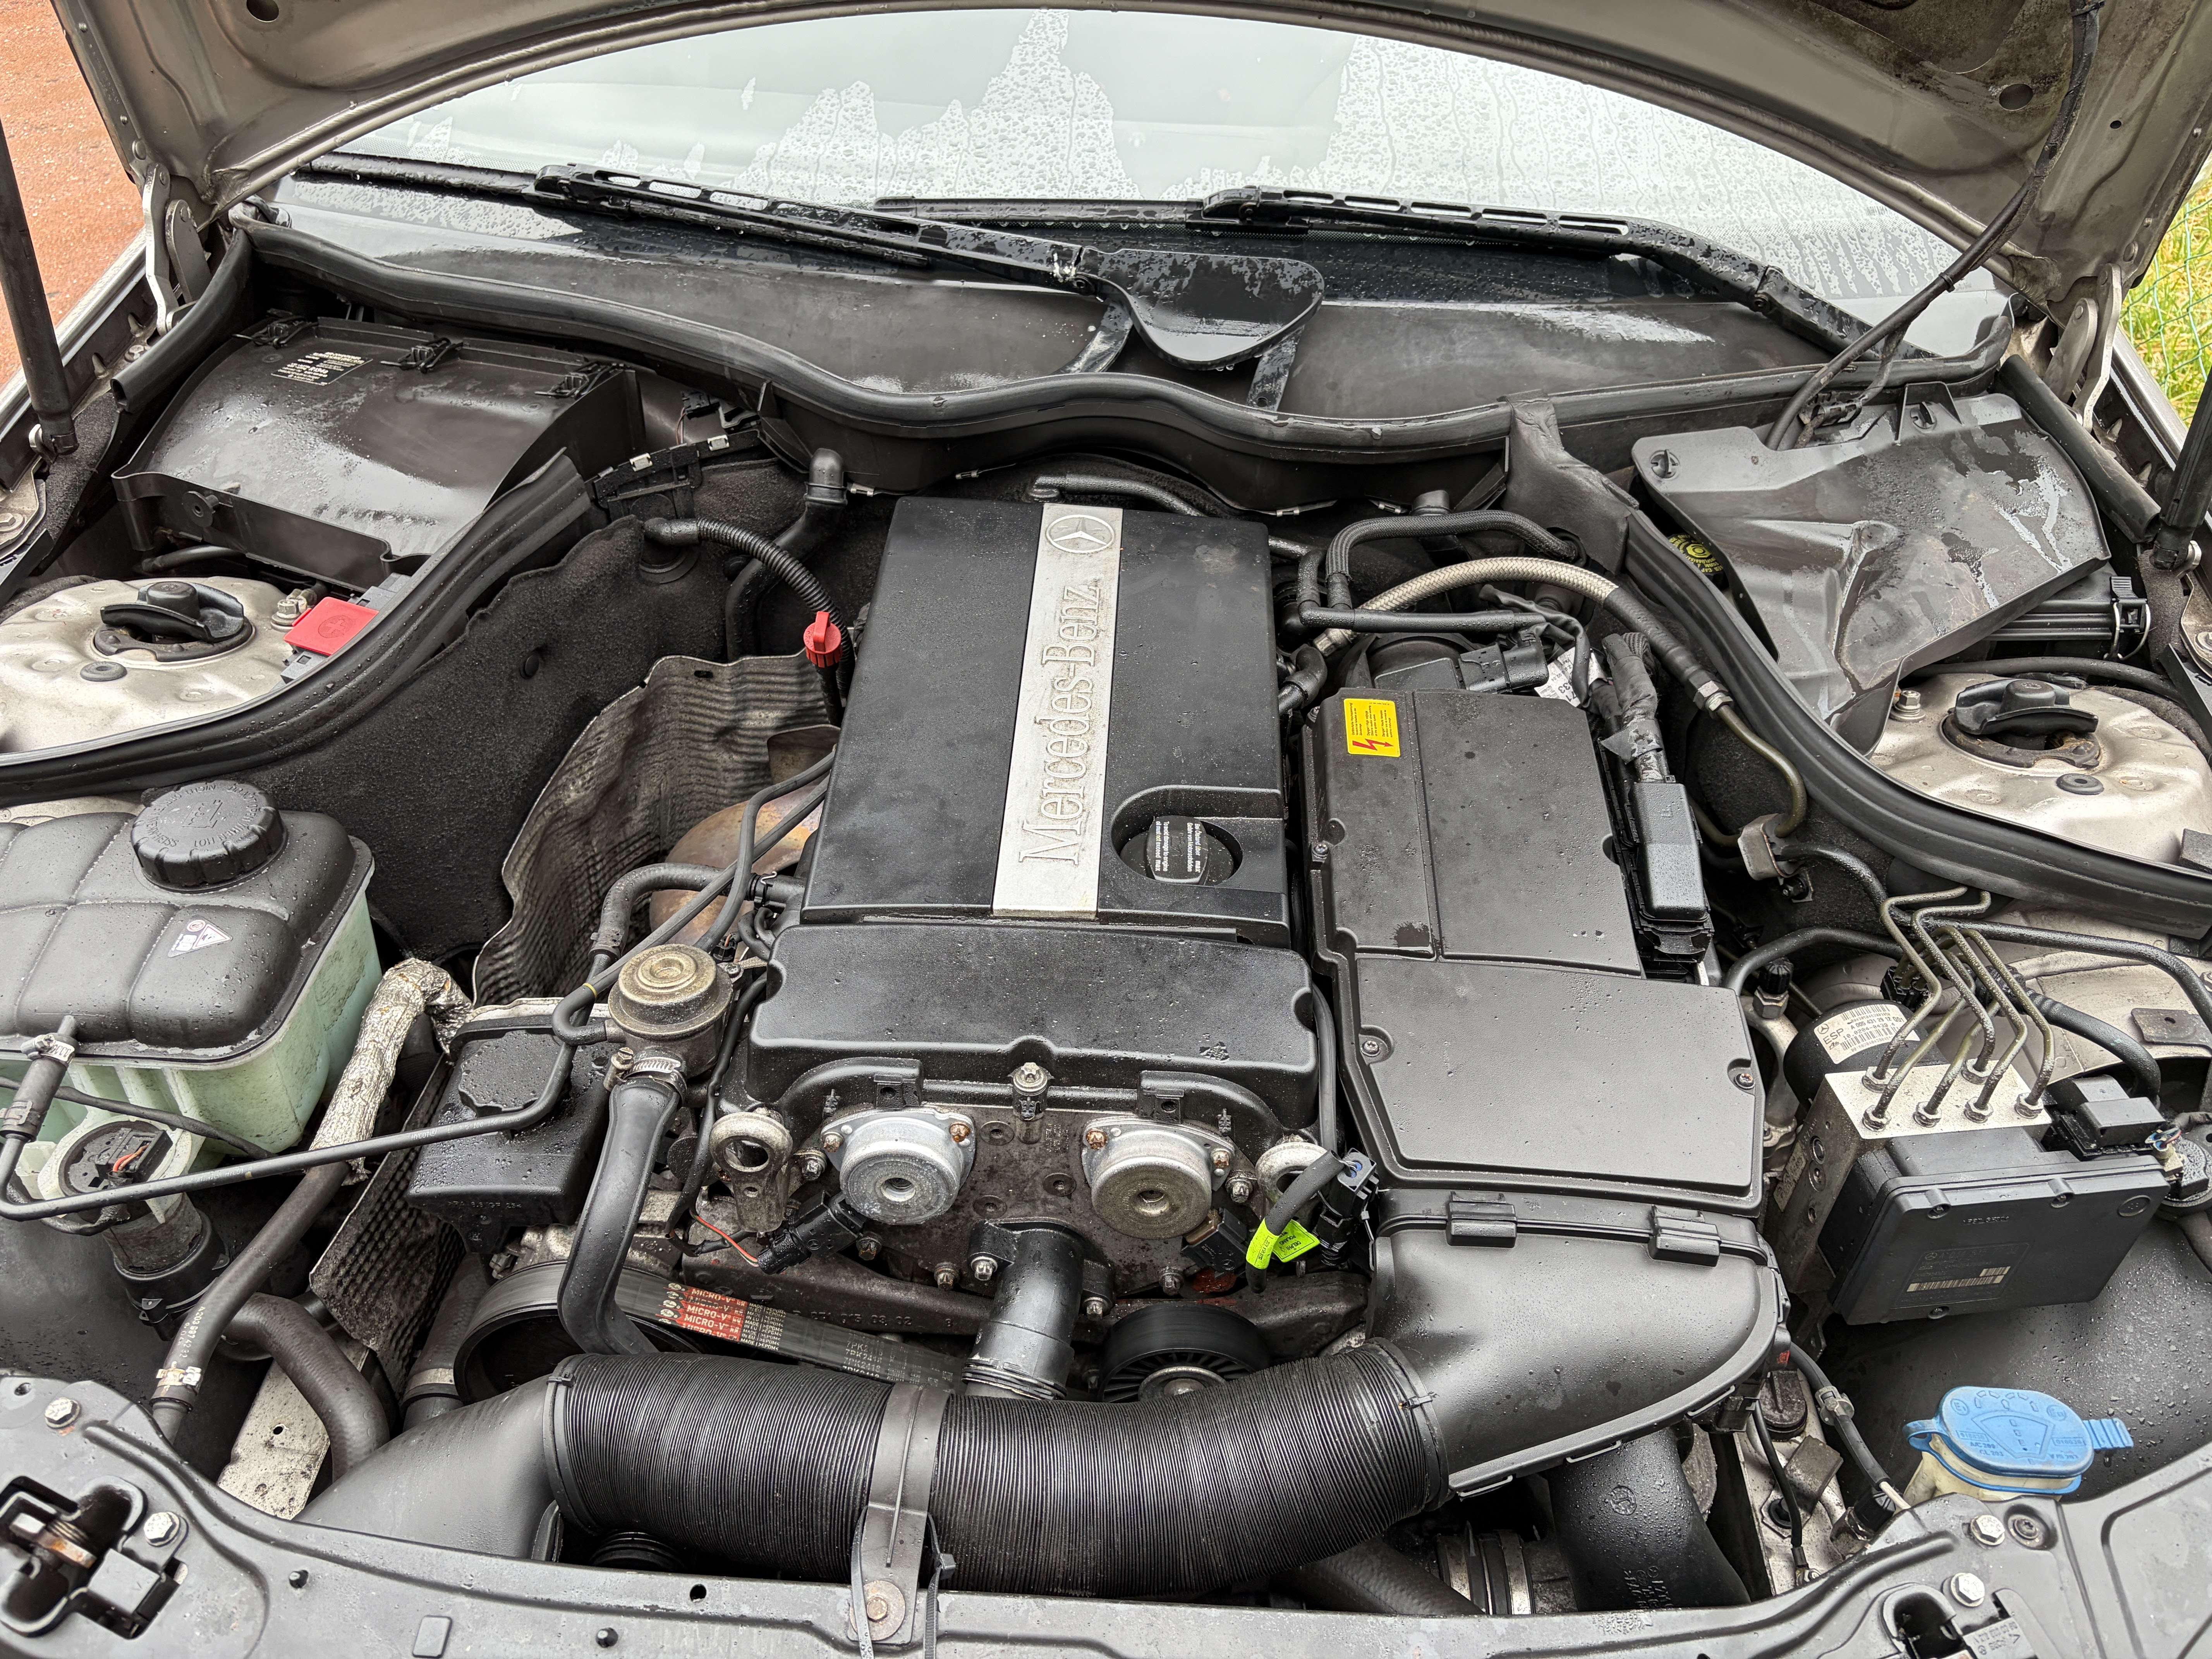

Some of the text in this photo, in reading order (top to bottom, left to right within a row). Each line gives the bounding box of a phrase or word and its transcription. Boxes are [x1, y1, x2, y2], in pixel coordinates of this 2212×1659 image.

[1019, 585, 1101, 865] Mercedes-Benz
[1823, 1028, 1844, 1044] ESP
[1278, 1234, 1297, 1246] POLAND
[1285, 1240, 1302, 1251] DELPHI
